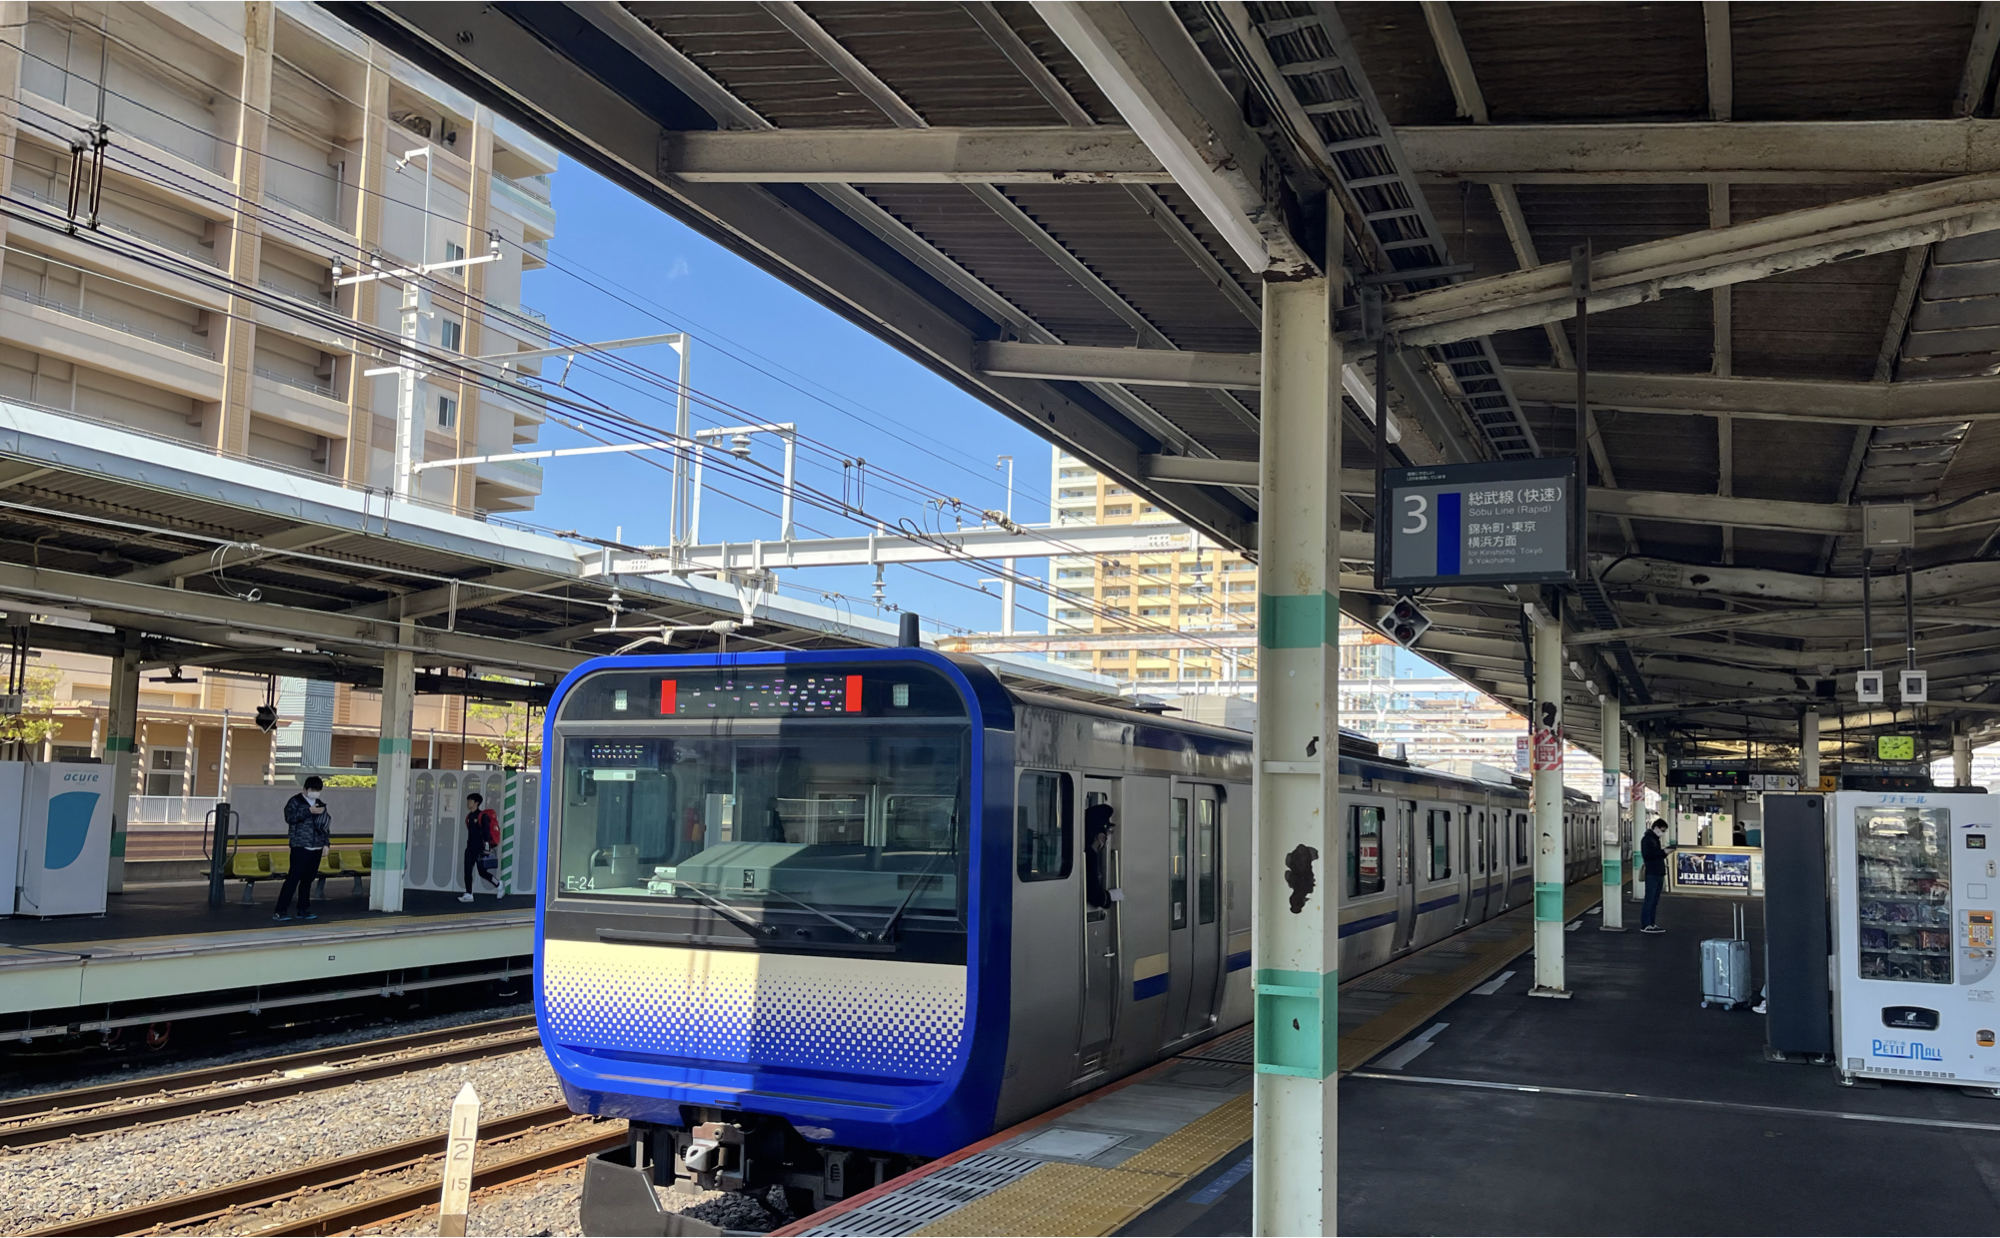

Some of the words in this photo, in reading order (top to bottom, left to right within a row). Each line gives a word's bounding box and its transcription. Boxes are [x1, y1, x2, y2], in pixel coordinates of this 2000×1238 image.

[1402, 494, 1428, 534] 3
[1495, 507, 1515, 515] Line
[1517, 504, 1552, 515] (Rapid)
[1468, 535, 1517, 548] 横浜方面
[1468, 549, 1478, 557] for
[1476, 557, 1516, 565] Yokohama
[1671, 760, 1678, 768] 3
[1919, 766, 1927, 775] 4
[64, 773, 99, 782] acure
[1878, 794, 1927, 804] プチモール
[1679, 872, 1705, 881] JEXER
[1707, 873, 1749, 882] LIGHTGYM
[1873, 1039, 1906, 1057] PETIT
[1910, 1042, 1943, 1061] MALL
[453, 1143, 469, 1160] 2
[451, 1177, 469, 1191] 15
